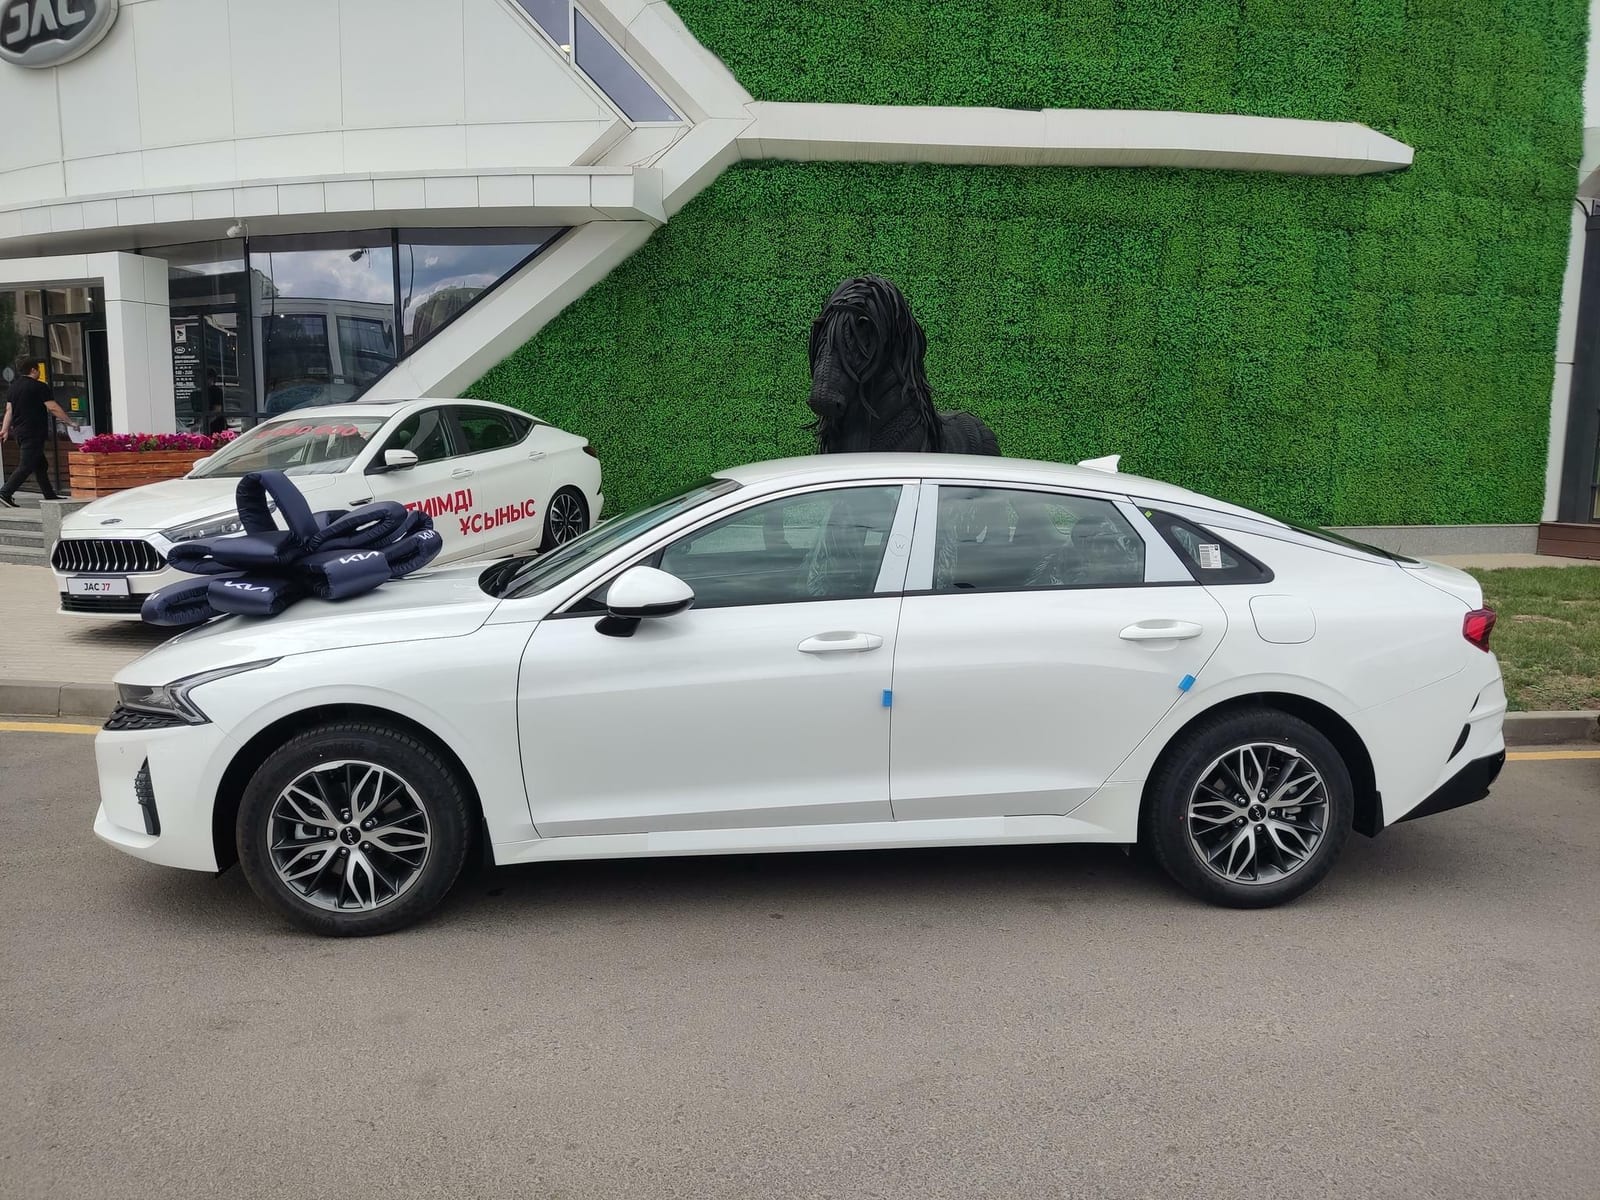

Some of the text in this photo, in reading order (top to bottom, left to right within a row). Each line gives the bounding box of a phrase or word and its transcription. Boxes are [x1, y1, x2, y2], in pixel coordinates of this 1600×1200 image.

[6, 0, 86, 44] JAC
[459, 499, 536, 536] ҰСЫНЫС
[84, 582, 110, 591] JAC J7
